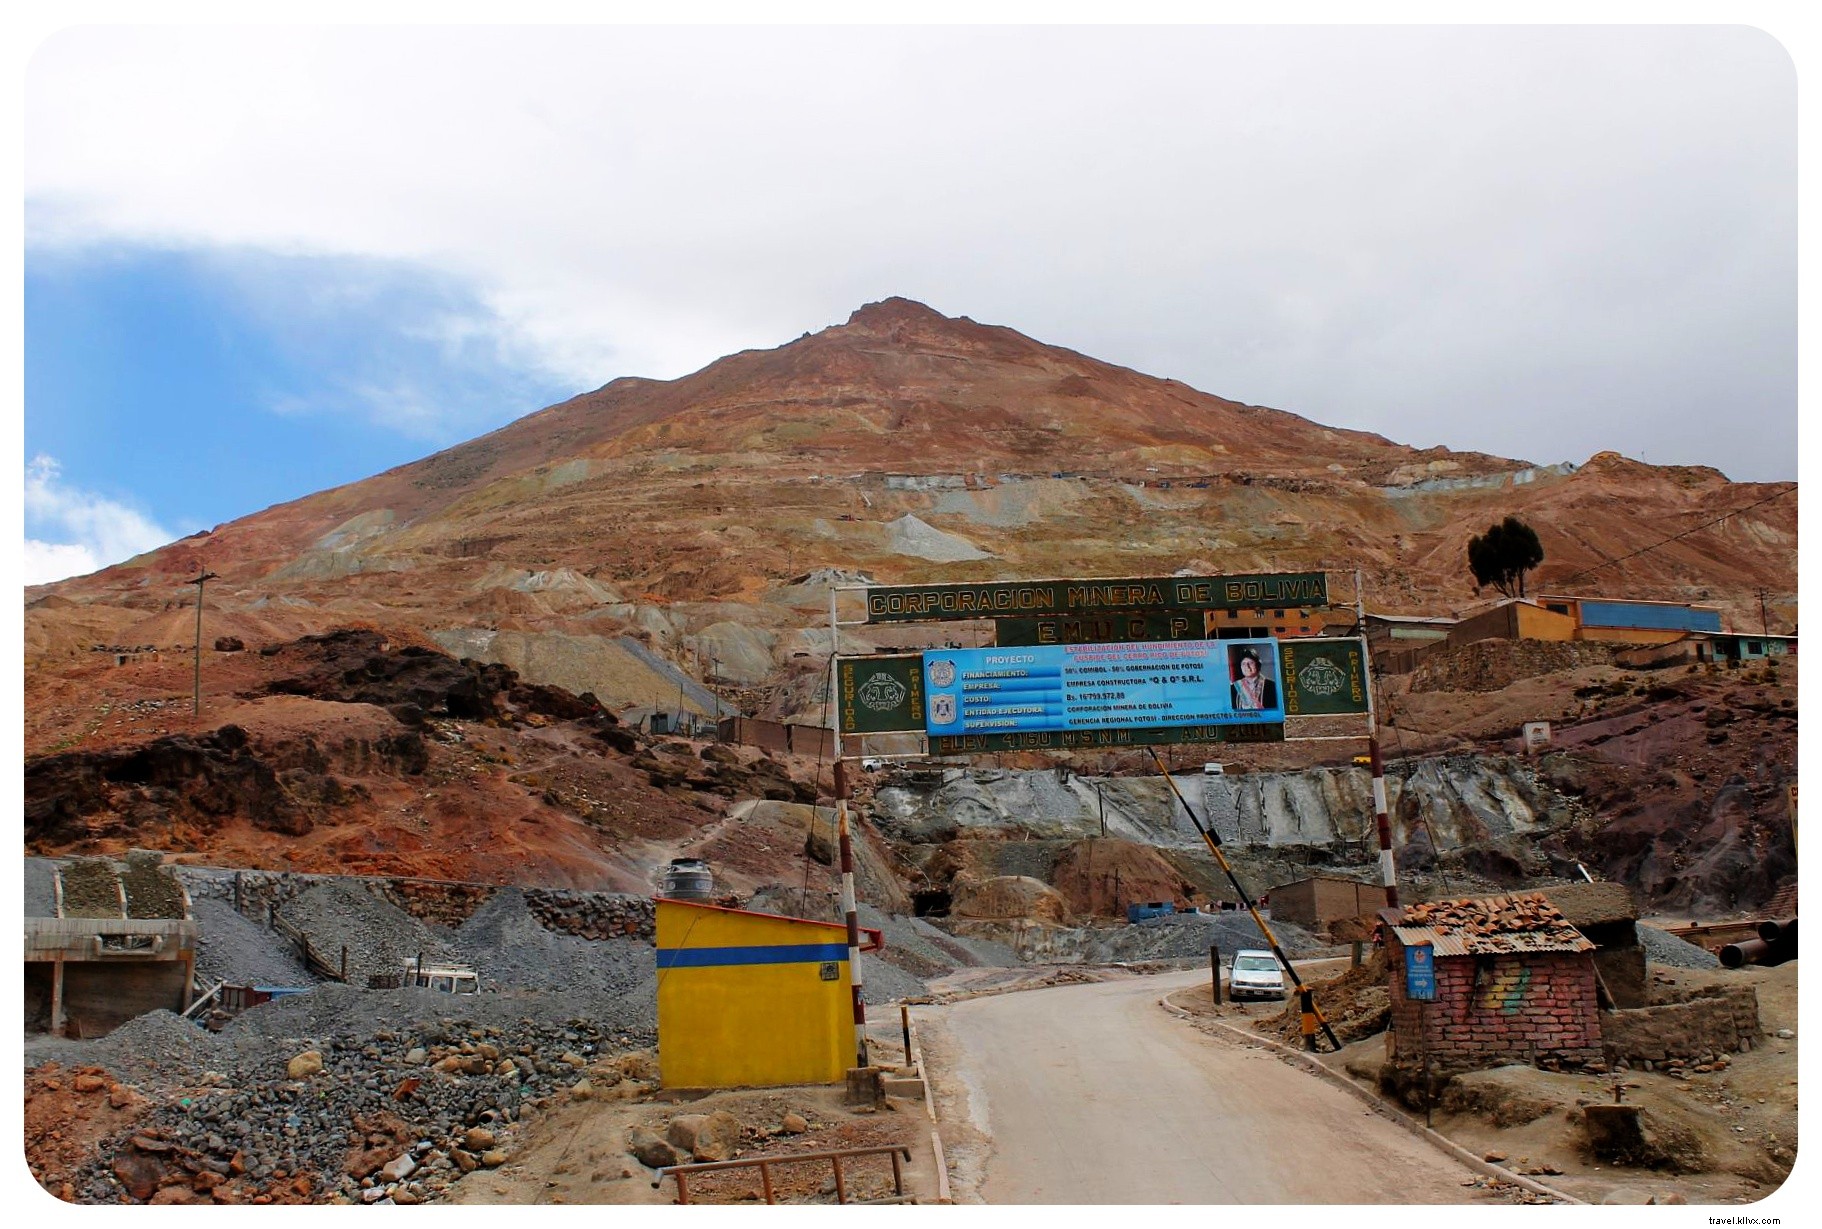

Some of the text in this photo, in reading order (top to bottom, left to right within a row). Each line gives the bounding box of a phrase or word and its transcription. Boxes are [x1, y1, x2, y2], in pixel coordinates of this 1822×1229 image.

[870, 579, 1326, 616] CORPORACION MINERA DE BOLIVIA
[986, 655, 1034, 664] PROYECTO
[1079, 666, 1107, 674] COMIBOL
[1096, 678, 1146, 686] CONSTRUCTORA
[1161, 676, 1168, 684] &
[1284, 648, 1298, 712] SEGURIDAD
[1348, 652, 1362, 702] PRIMERO
[844, 664, 855, 730] SEGURIDAD
[910, 668, 922, 720] PRIMERO
[964, 708, 996, 716] ENTIDAD
[1102, 716, 1133, 724] REGIONAL
